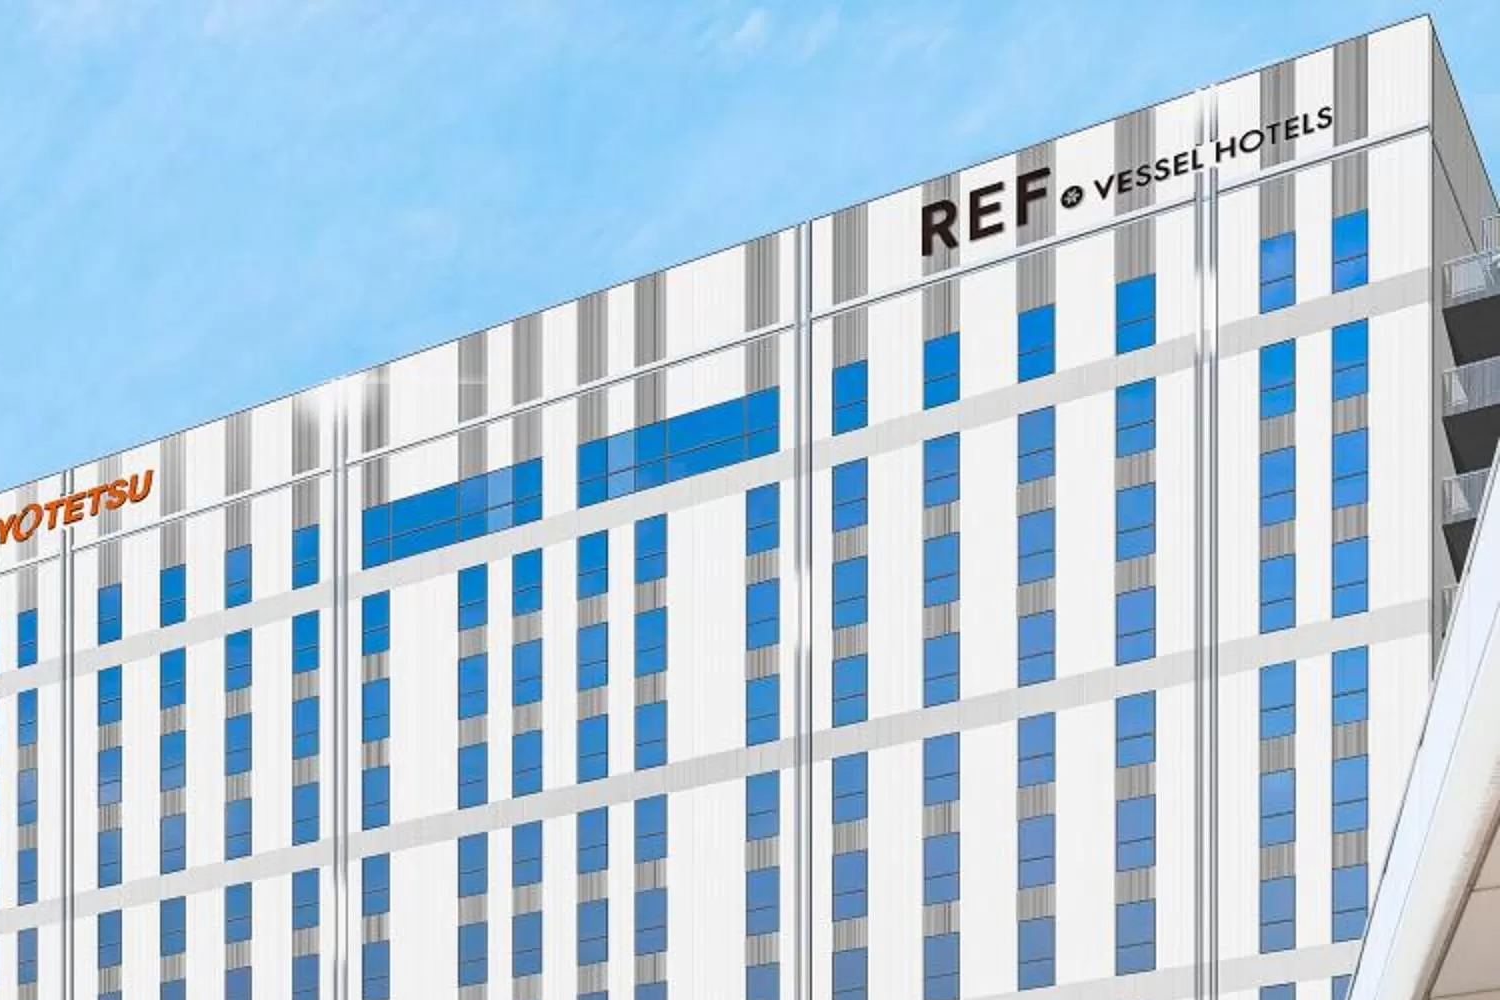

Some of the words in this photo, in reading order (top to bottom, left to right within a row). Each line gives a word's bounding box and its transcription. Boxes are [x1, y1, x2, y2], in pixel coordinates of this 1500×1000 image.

[921, 167, 1051, 257] REF
[1094, 149, 1204, 201] VESSEL
[1214, 106, 1333, 164] HOTELS
